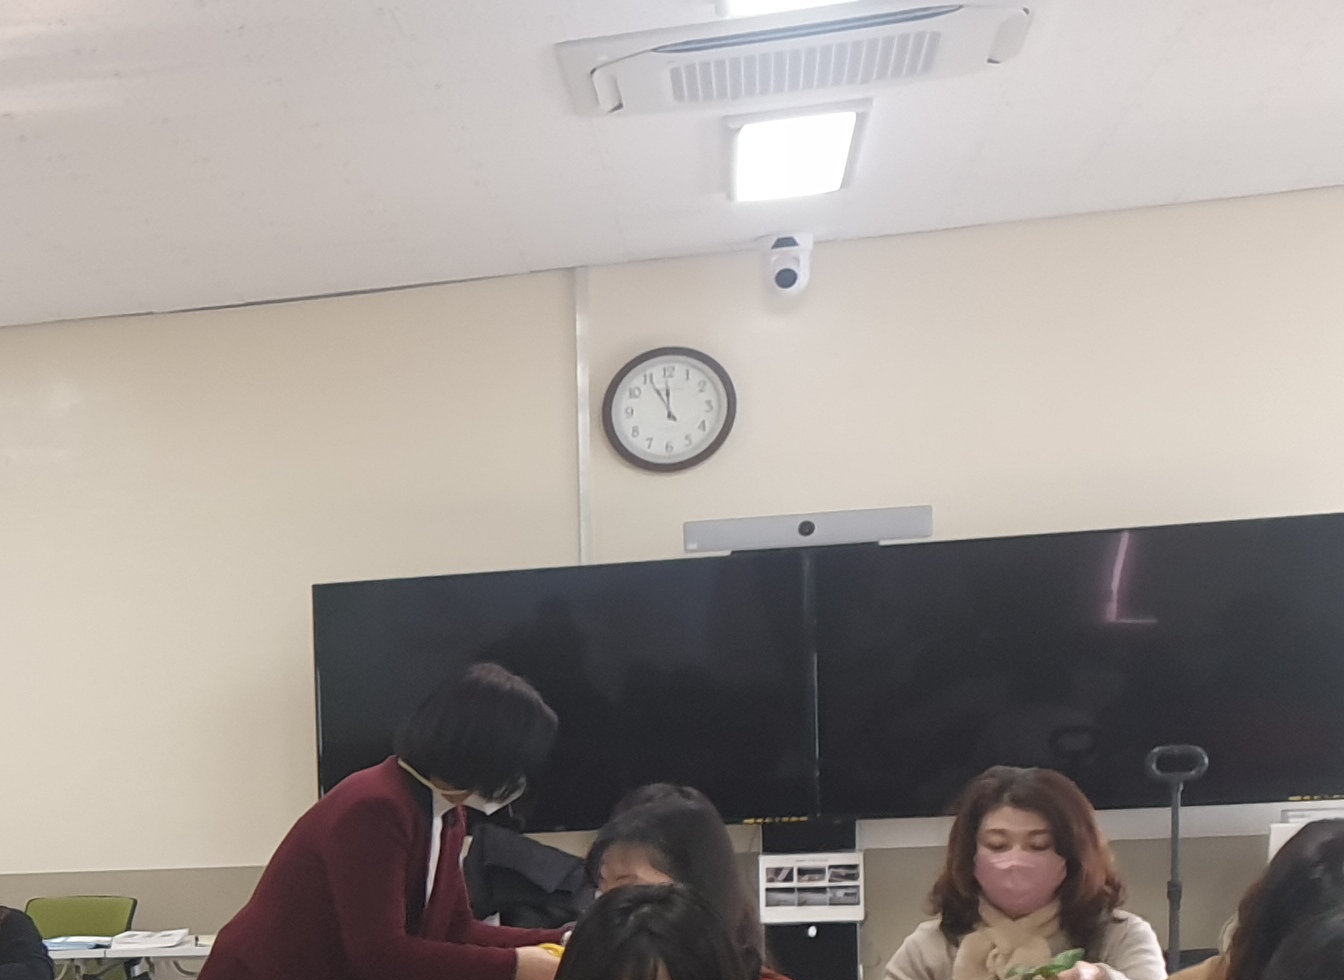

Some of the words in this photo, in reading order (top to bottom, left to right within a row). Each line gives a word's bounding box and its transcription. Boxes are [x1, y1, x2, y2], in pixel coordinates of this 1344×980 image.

[663, 366, 675, 378] 12
[685, 369, 690, 380] 1
[629, 386, 641, 399] 10
[698, 381, 706, 393] 2
[705, 400, 713, 413] 3
[625, 407, 634, 419] 9
[631, 426, 640, 438] 8
[697, 420, 706, 432] 4
[645, 437, 653, 449] 7
[685, 434, 692, 447] 5
[665, 441, 673, 453] 6
